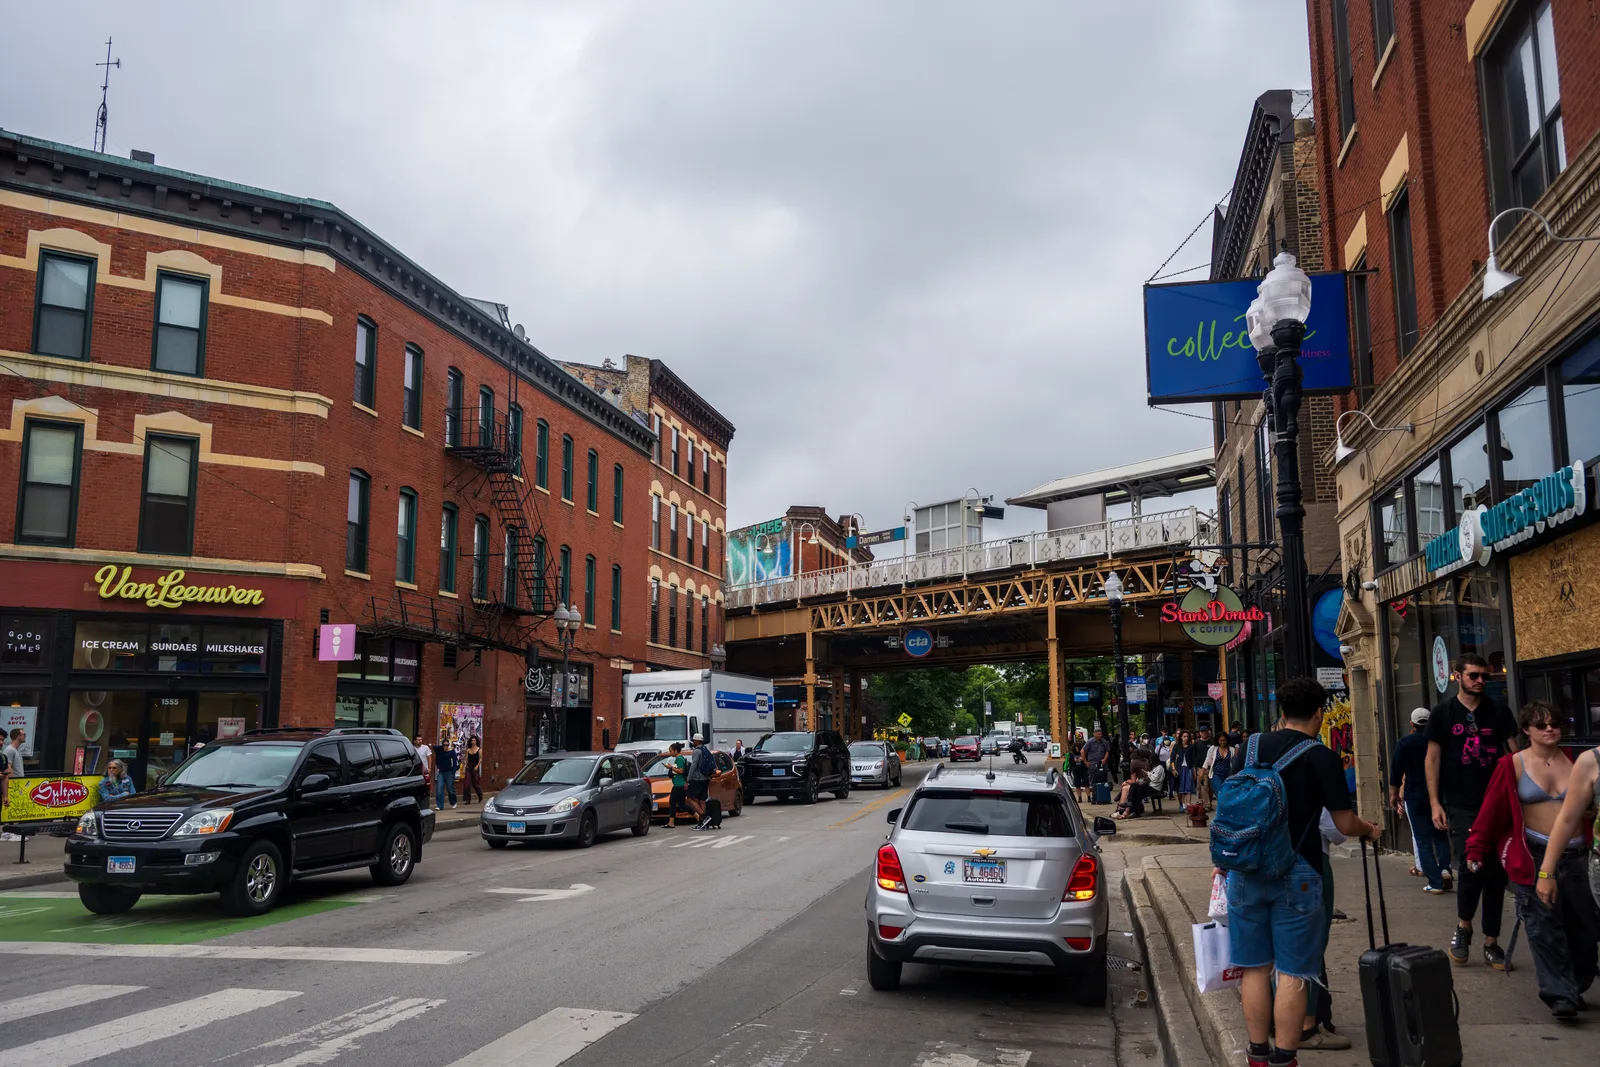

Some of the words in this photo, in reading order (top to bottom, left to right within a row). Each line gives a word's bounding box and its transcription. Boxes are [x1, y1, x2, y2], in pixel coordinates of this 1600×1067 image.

[1301, 349, 1331, 358] fitness
[859, 535, 880, 545] Damen
[1161, 602, 1208, 623] Stan's
[1207, 600, 1265, 622] Donuts
[1199, 625, 1234, 633] COFFEE
[8, 630, 41, 641] GOOD
[82, 640, 100, 649] ICE
[102, 640, 139, 650] CREAM
[152, 642, 198, 652] SUNDAES
[206, 644, 264, 654] MILKSHAKES
[908, 636, 928, 647] cta
[7, 643, 41, 653] TIMES
[633, 689, 696, 703] PENSKE
[161, 698, 179, 706] 1555
[647, 702, 664, 710] Truck
[663, 701, 684, 709] Rental
[32, 780, 88, 800] Sultan's
[46, 797, 77, 808] Market
